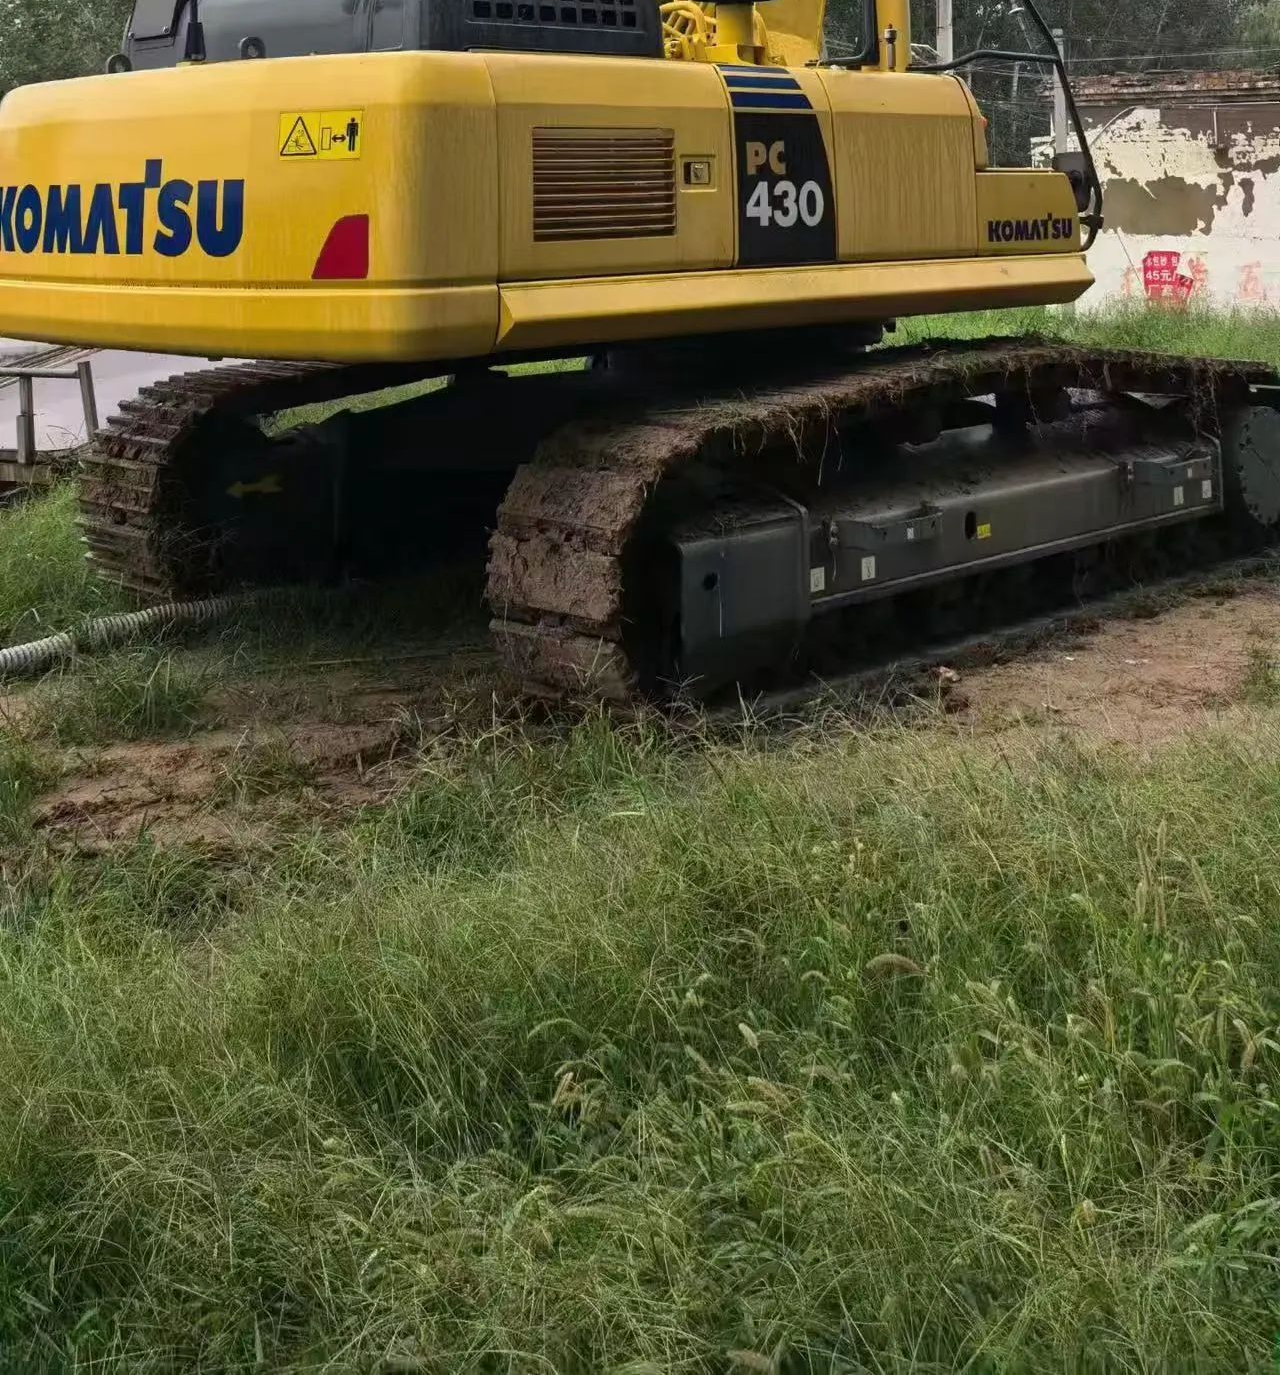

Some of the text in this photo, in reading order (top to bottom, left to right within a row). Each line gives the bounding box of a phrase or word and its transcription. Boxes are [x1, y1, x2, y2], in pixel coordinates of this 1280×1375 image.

[746, 140, 786, 175] PC
[0, 158, 244, 257] KOMATSU
[746, 180, 824, 227] 430
[988, 212, 1072, 242] KOMATSU
